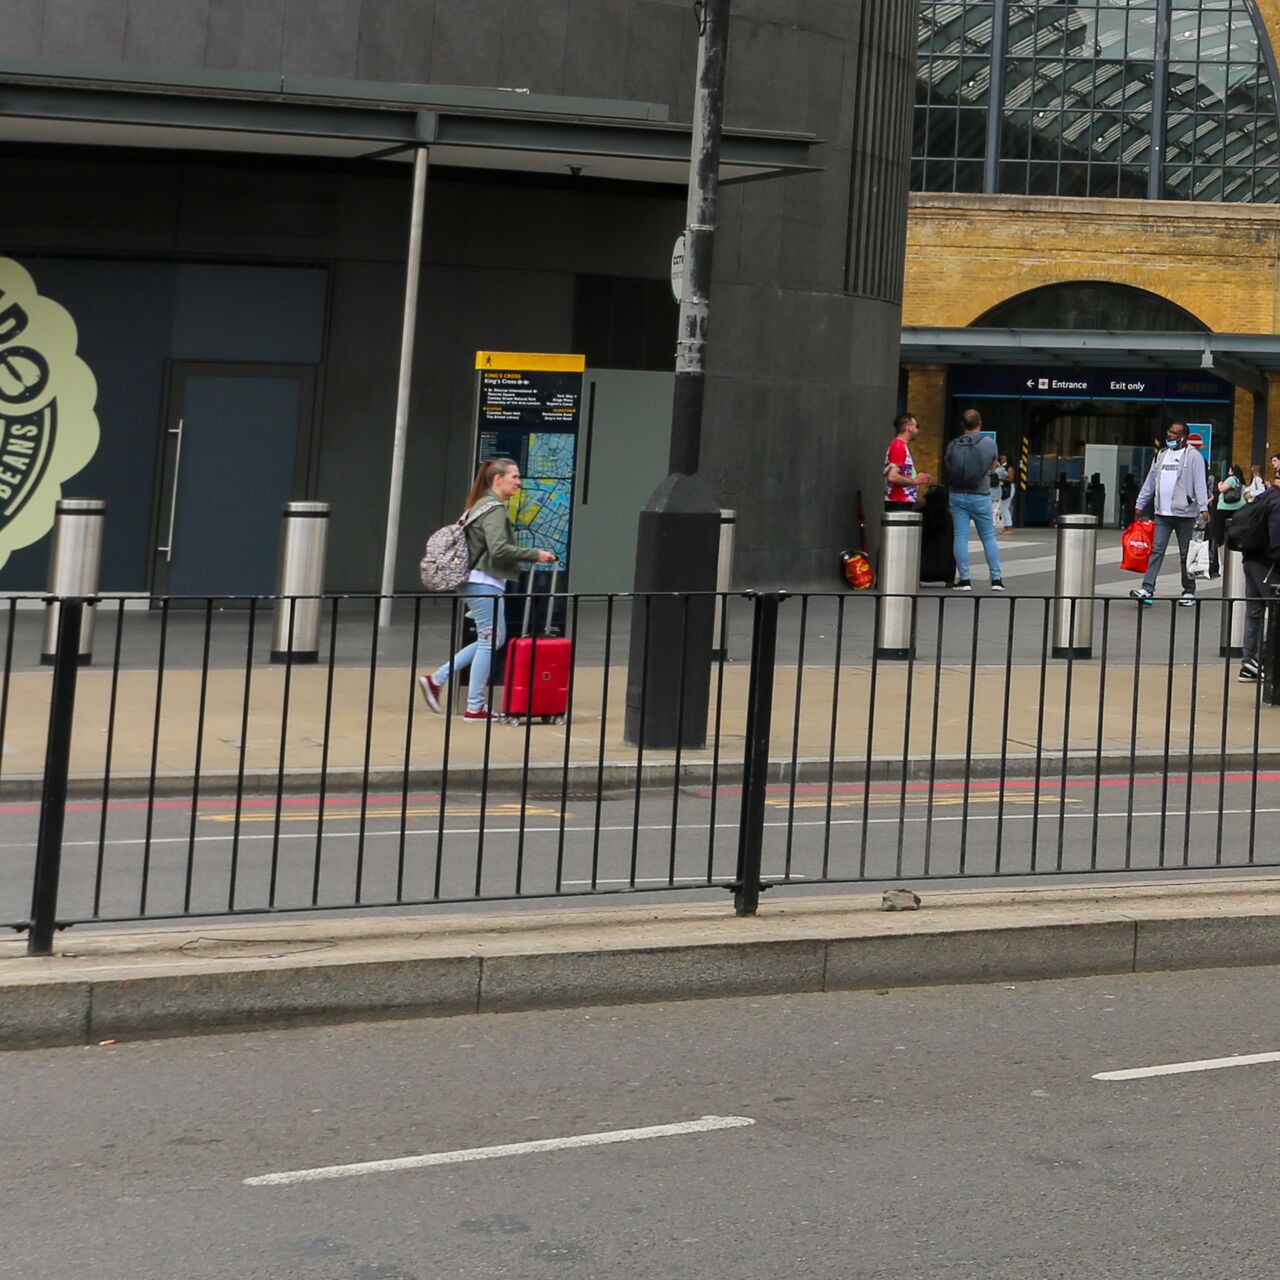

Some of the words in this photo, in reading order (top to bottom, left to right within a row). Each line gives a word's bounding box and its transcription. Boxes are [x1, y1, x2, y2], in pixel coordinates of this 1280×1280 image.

[1052, 380, 1088, 389] Entrance
[1110, 381, 1125, 390] Exit
[1127, 382, 1145, 392] only
[0, 423, 39, 500] BEANS
